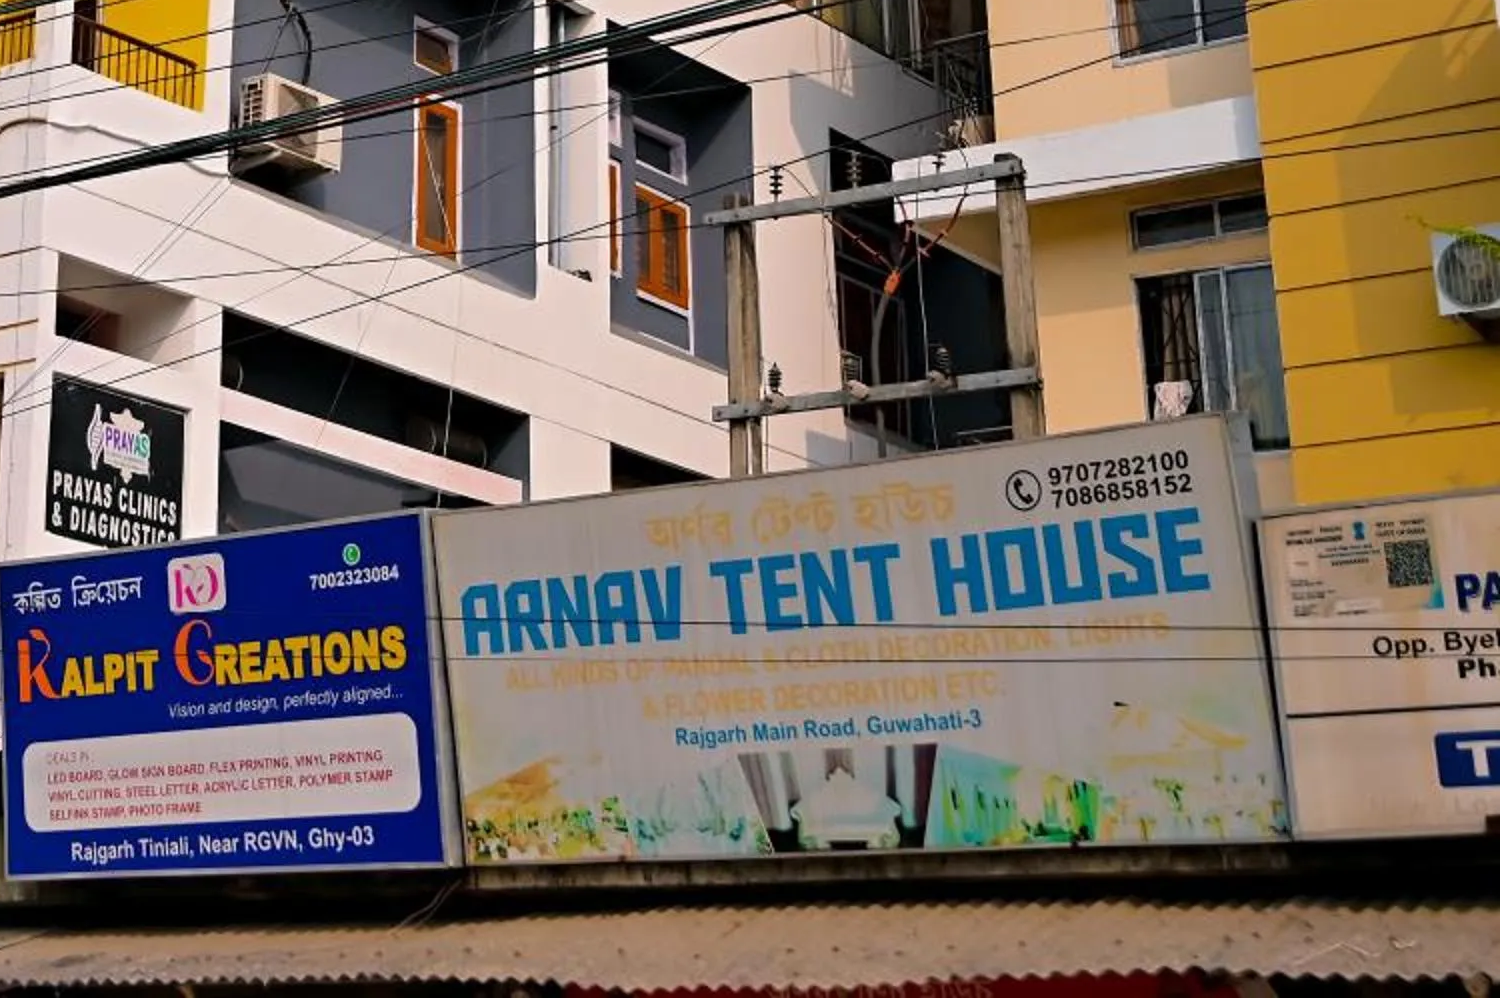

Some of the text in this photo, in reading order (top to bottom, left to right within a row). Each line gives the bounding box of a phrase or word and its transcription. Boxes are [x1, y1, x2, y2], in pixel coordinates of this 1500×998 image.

[105, 426, 150, 459] PRAYAS
[1047, 449, 1189, 486] 9707282100
[53, 469, 177, 527] PRAYAS CLINICS
[1051, 473, 1193, 509] 7086858152
[51, 501, 63, 528] &
[309, 564, 400, 590] 7002323084
[460, 564, 682, 656] ARNAV
[710, 542, 901, 635] TENT
[931, 507, 1210, 618] HOUSE
[506, 666, 540, 690] ALL
[553, 660, 619, 690] KINDS
[626, 658, 652, 682] OF
[661, 651, 757, 680] PANDAL
[785, 640, 870, 669] CLOTH
[1067, 611, 1171, 647] LIGHTS
[1372, 635, 1435, 659] Opp.
[168, 703, 205, 719] Vision
[208, 698, 232, 715] and
[283, 687, 340, 712] perfectly
[665, 689, 767, 719] FLOWER
[774, 672, 937, 711] DECORATION
[675, 708, 982, 750] Rajgarh Main Road, Guwahati-3
[108, 766, 139, 781] GLOW
[141, 764, 165, 779] SIGN
[209, 760, 237, 774] FLEX
[294, 752, 327, 768] VINYL
[329, 749, 383, 766] PRINTING
[49, 788, 77, 803] VINYL
[125, 784, 159, 799] STEEL
[203, 778, 249, 794] ACRYLIC
[299, 771, 351, 788] POLYMER
[355, 769, 393, 784] STAMP
[129, 802, 164, 818] PHOTO
[165, 800, 202, 815] FRAME
[71, 825, 375, 865] Rajgarh Tiniali, Near RGVN, Ghy-03
